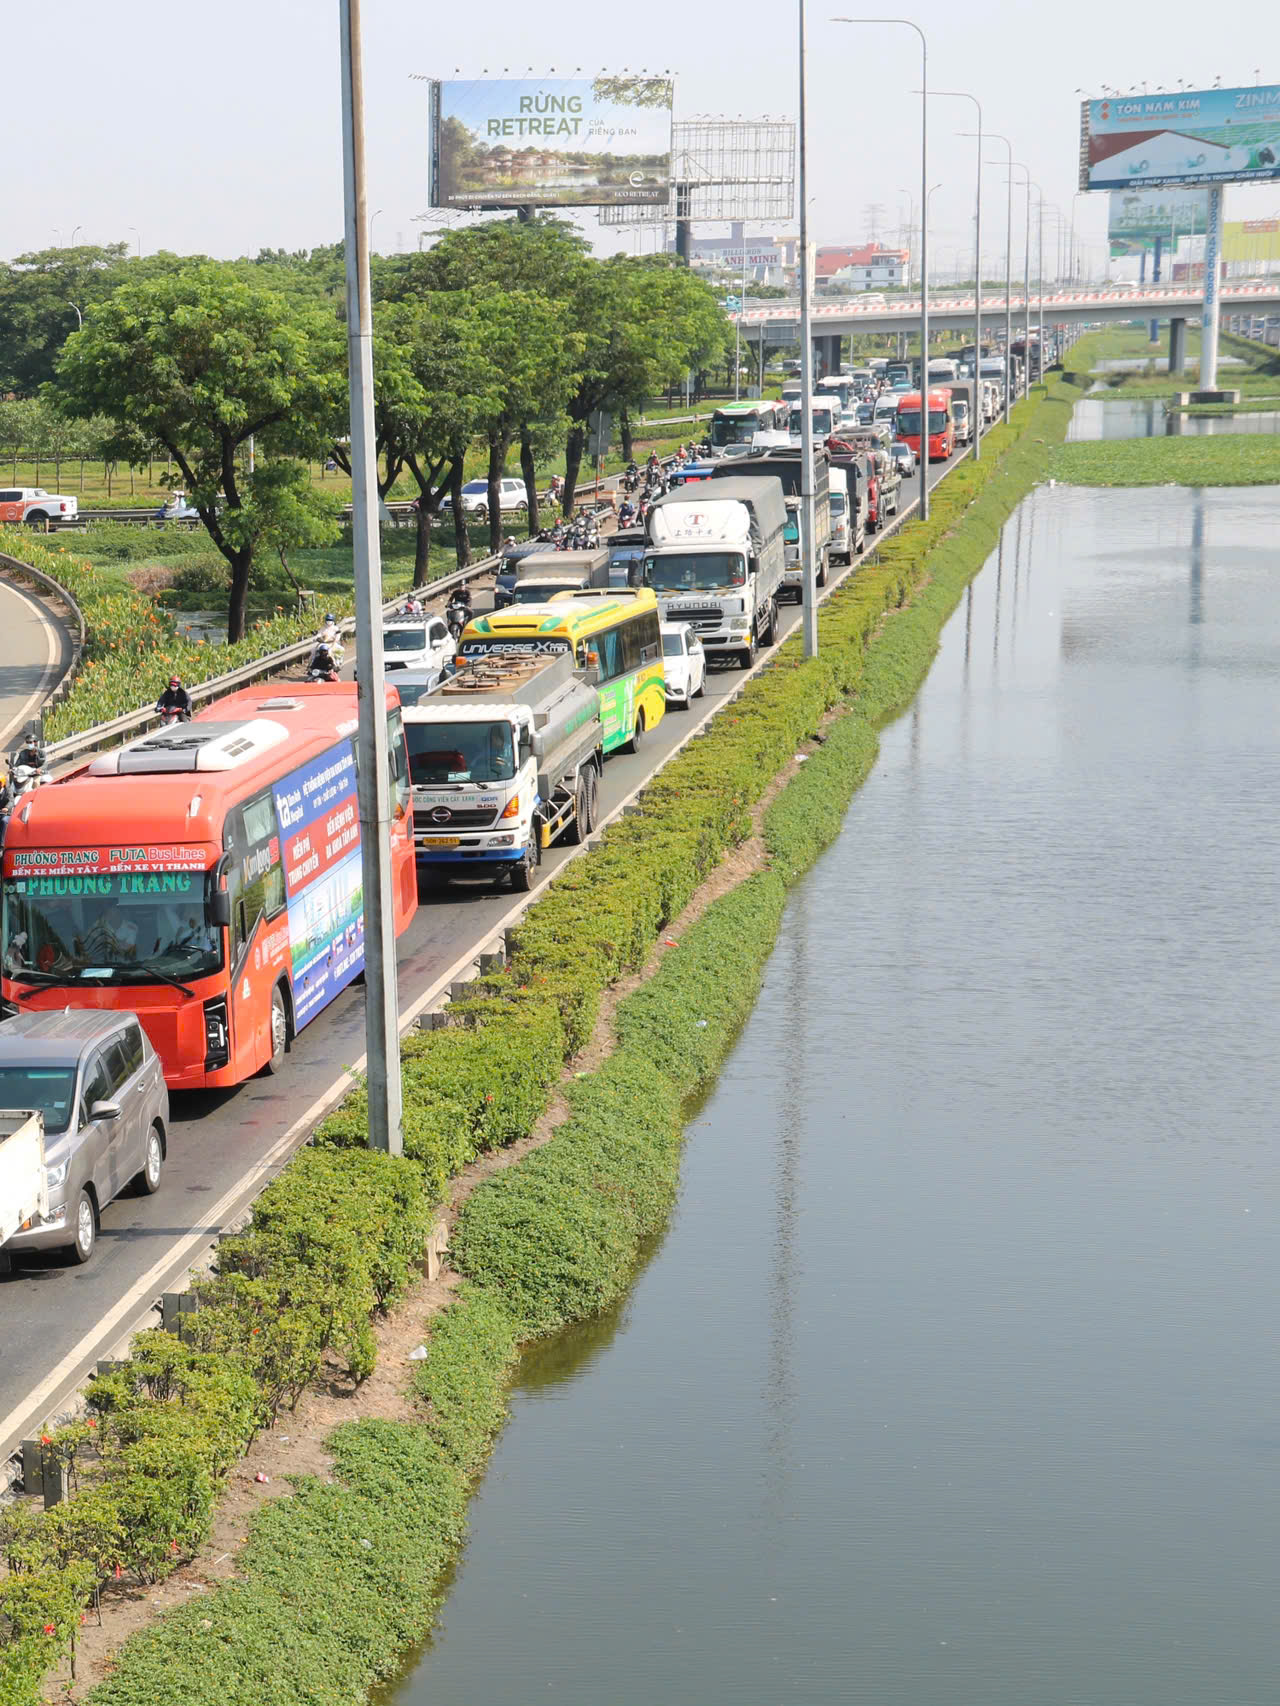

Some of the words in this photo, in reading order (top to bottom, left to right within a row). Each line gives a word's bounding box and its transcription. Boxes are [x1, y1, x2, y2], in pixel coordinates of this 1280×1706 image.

[519, 90, 583, 113] RỪNG
[1145, 101, 1175, 113] NAM
[1179, 98, 1201, 110] KIM
[487, 117, 583, 136] RETREAT
[722, 248, 761, 256] BILLIRDS
[749, 255, 777, 264] MINH
[667, 602, 721, 610] HYUNDAI
[462, 643, 535, 653] UNIVERSE
[14, 850, 57, 866] PHƯƠNG
[60, 851, 99, 865] TRANG
[109, 849, 146, 862] FUTA
[148, 848, 171, 861] Bus
[171, 846, 206, 860] Lines
[12, 865, 32, 876] BẾN
[33, 868, 47, 876] XE
[77, 865, 99, 874] TÂY
[109, 862, 132, 872] BẾN
[151, 863, 165, 872] VỊ
[166, 863, 206, 871] THANH
[117, 872, 192, 894] TRANG
